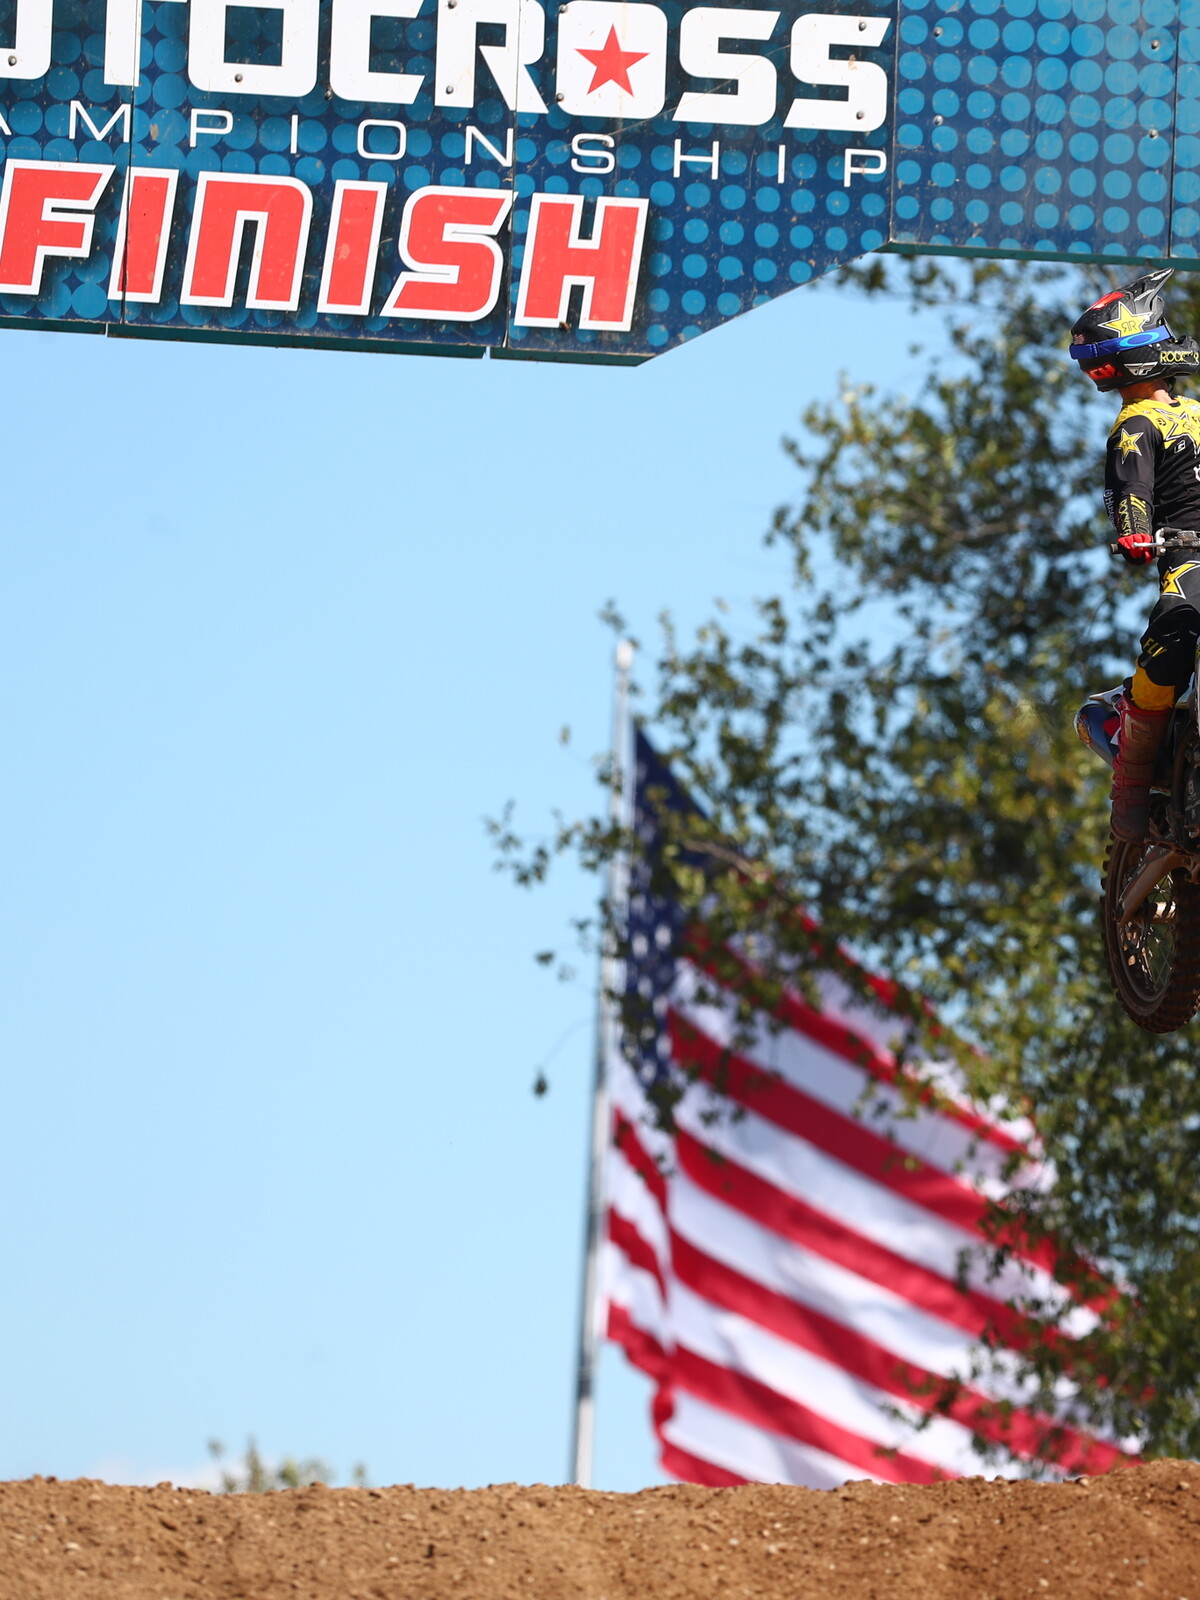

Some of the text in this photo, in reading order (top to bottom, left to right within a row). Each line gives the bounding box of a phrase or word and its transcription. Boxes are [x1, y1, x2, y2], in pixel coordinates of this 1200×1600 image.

[0, 100, 887, 187] MPIONSHIP
[0, 158, 649, 332] FINISH
[1143, 637, 1168, 657] FLY
